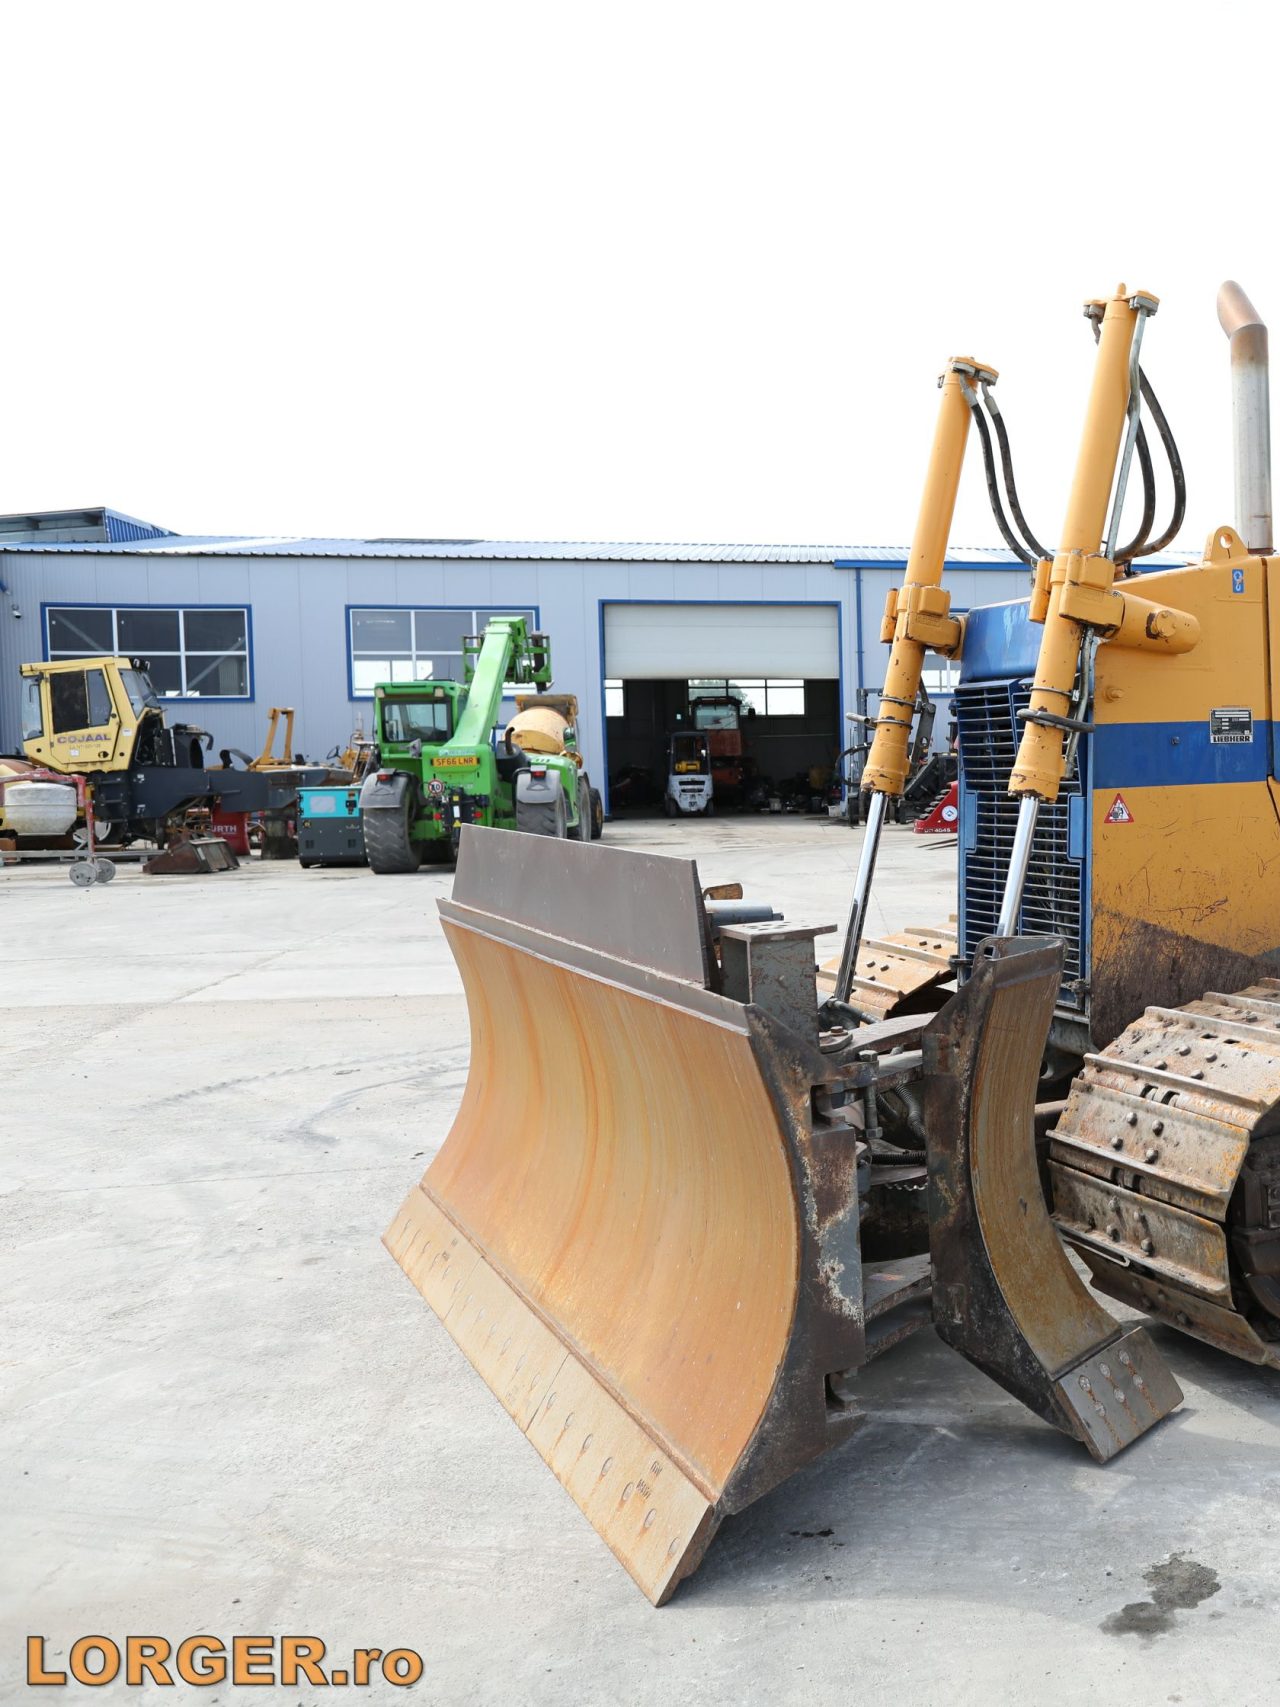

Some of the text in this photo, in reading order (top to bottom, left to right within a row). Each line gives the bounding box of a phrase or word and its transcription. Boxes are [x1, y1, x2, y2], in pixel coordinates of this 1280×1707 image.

[1213, 735, 1250, 743] LIEBHERR
[436, 757, 474, 766] SF66 LNR
